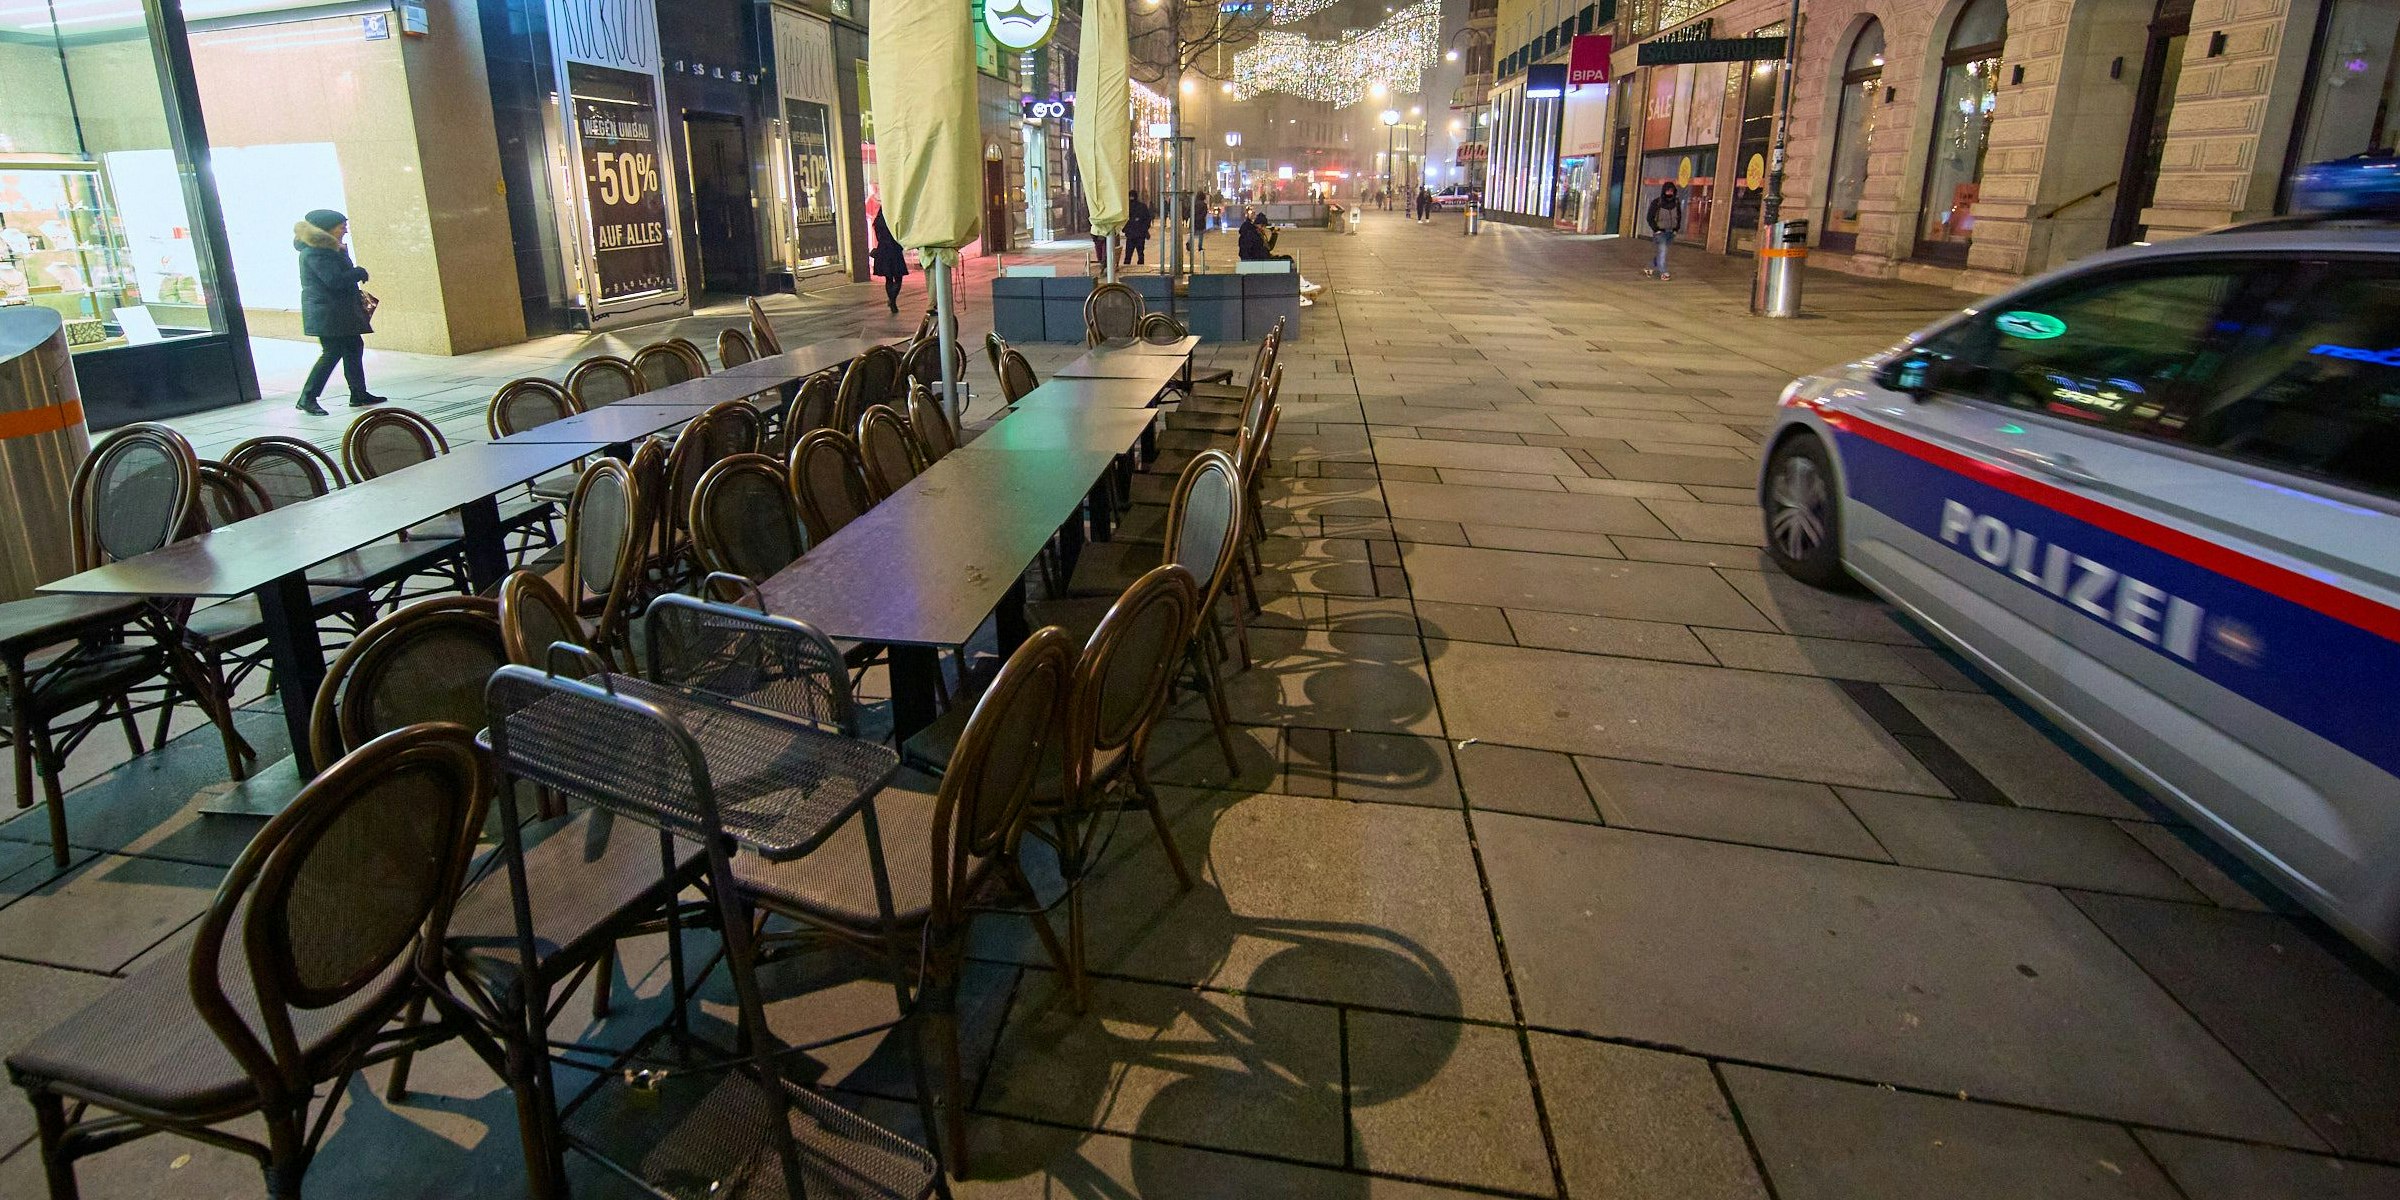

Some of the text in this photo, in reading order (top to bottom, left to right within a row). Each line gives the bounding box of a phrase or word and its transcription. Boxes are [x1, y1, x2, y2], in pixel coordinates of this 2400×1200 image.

[1573, 69, 1604, 81] BIPA
[1647, 94, 1673, 121] SALE
[583, 118, 649, 138] WEGEN UMBAU
[590, 152, 658, 206] -50%
[794, 153, 830, 193] -50%
[599, 222, 663, 248] AUF ALLES
[1940, 497, 2205, 664] POLIZEI
